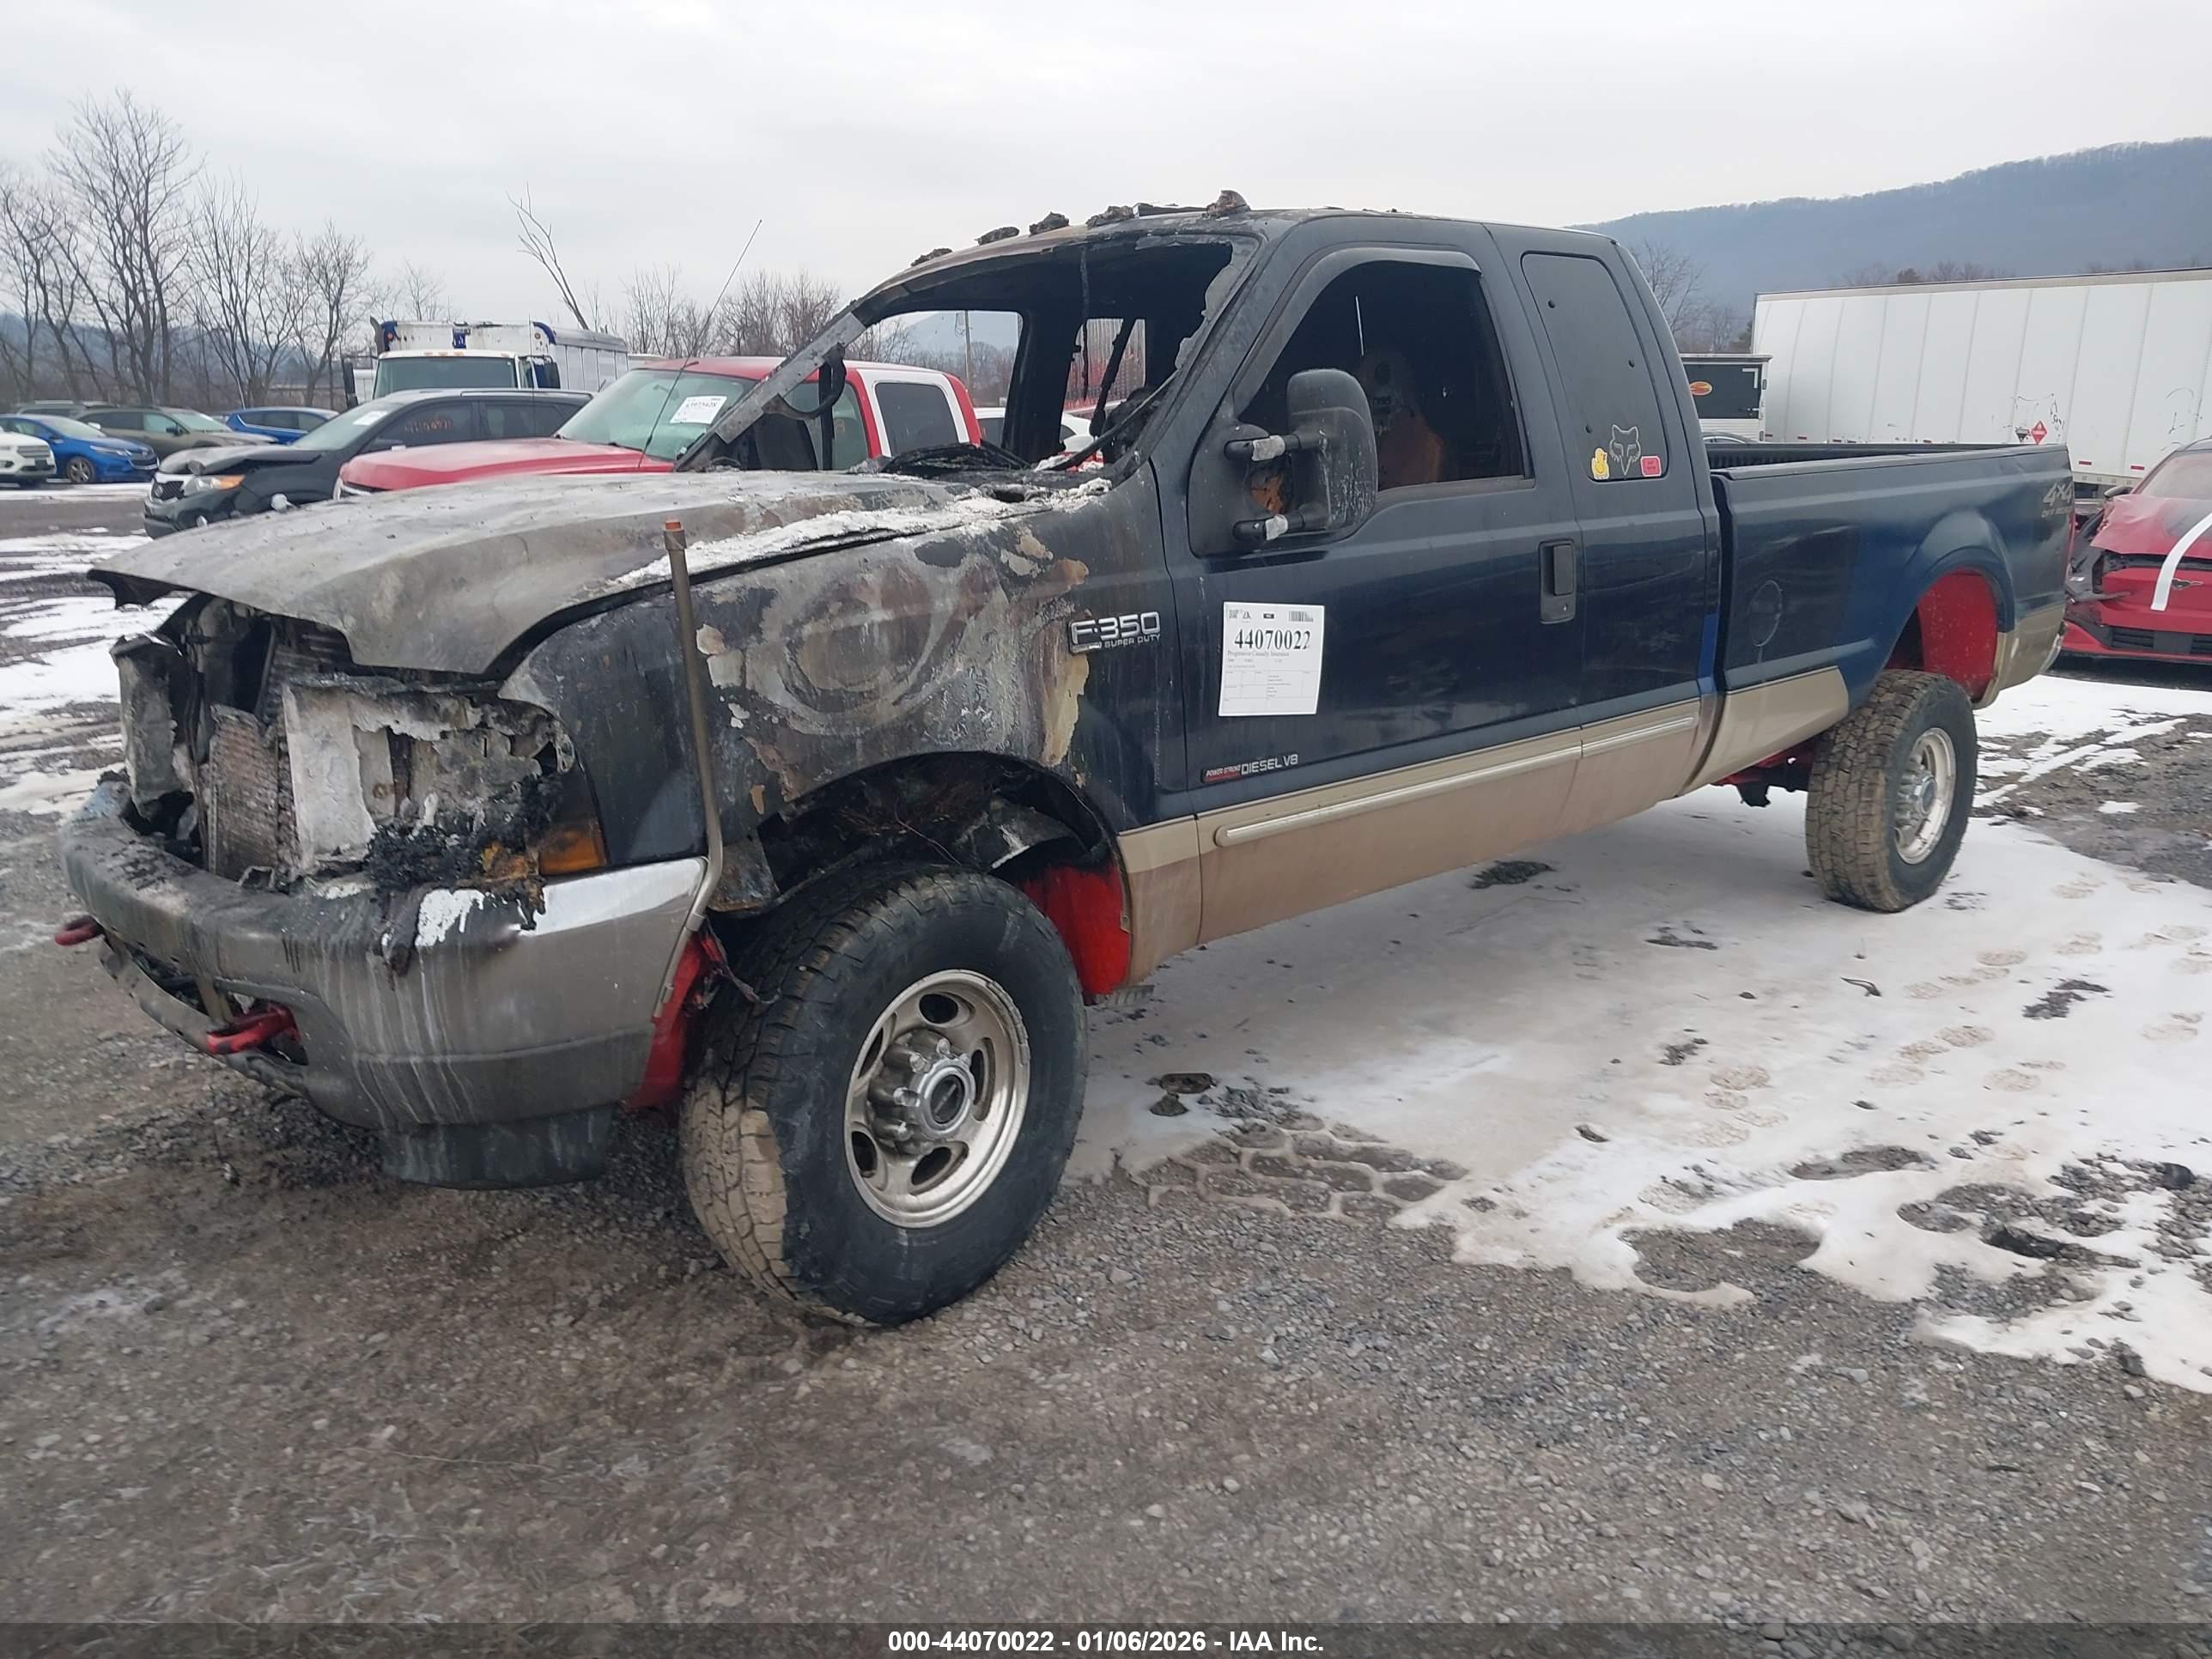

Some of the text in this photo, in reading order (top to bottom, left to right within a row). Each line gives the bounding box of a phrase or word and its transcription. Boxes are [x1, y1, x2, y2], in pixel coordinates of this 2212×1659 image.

[1104, 633, 1161, 648] SUPER DUTY
[1234, 628, 1310, 650] 44070022
[1242, 757, 1283, 775] DIESEL
[1283, 754, 1298, 767] V8
